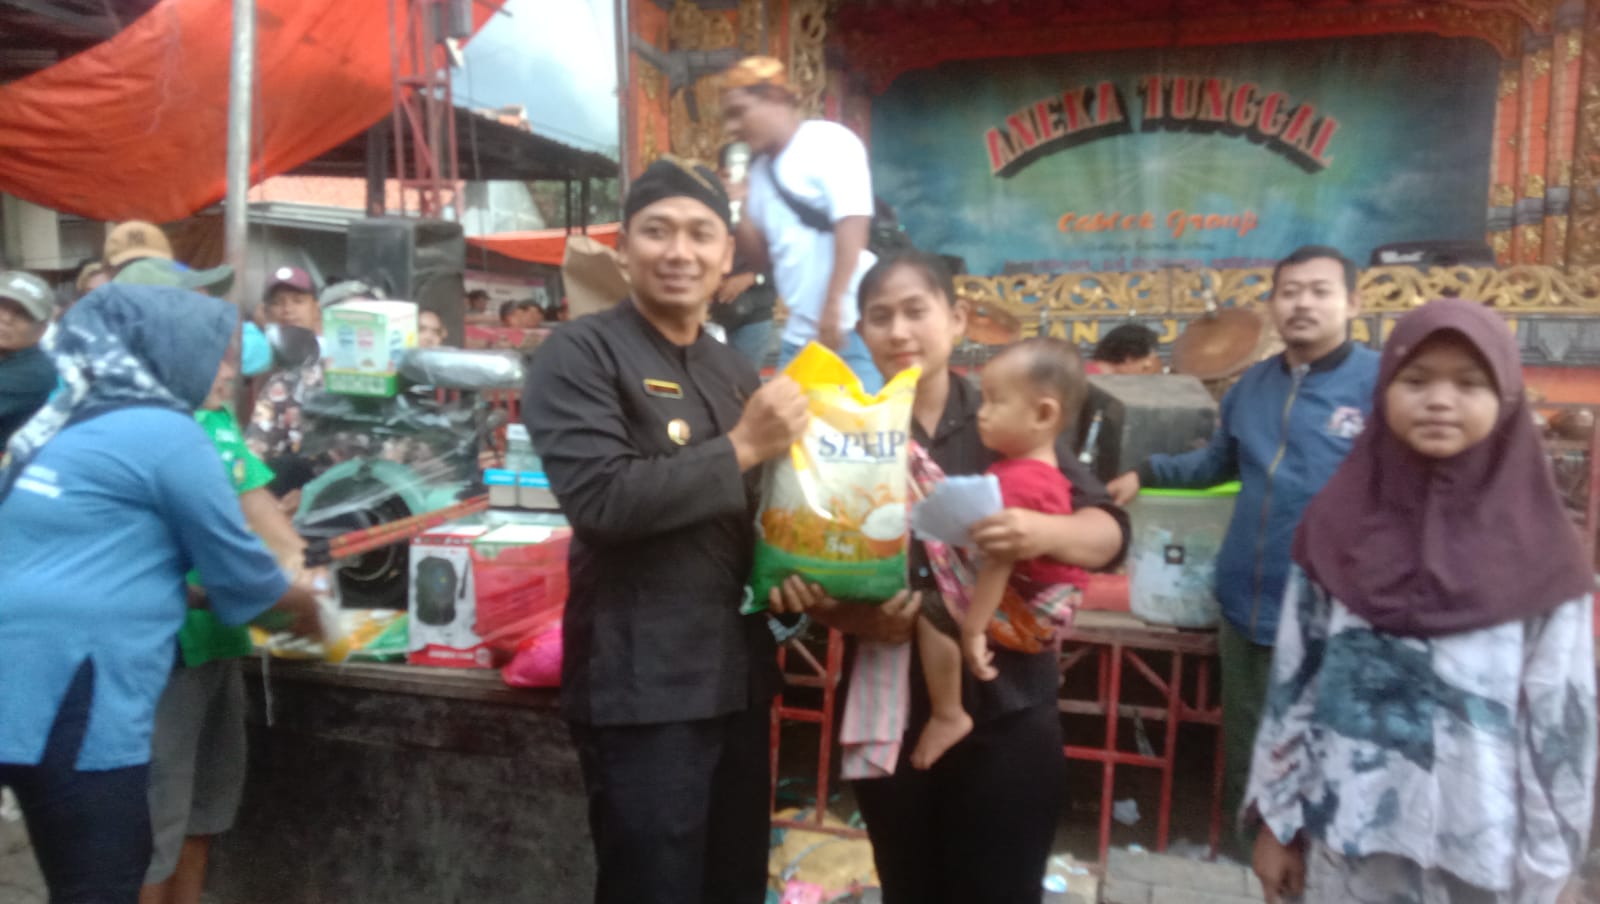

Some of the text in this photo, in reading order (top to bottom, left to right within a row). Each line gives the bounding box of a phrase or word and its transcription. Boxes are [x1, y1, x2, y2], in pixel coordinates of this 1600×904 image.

[985, 74, 1340, 176] ANEKA TUNGGAL
[1166, 209, 1258, 238] Group
[817, 429, 906, 457] SPHP
